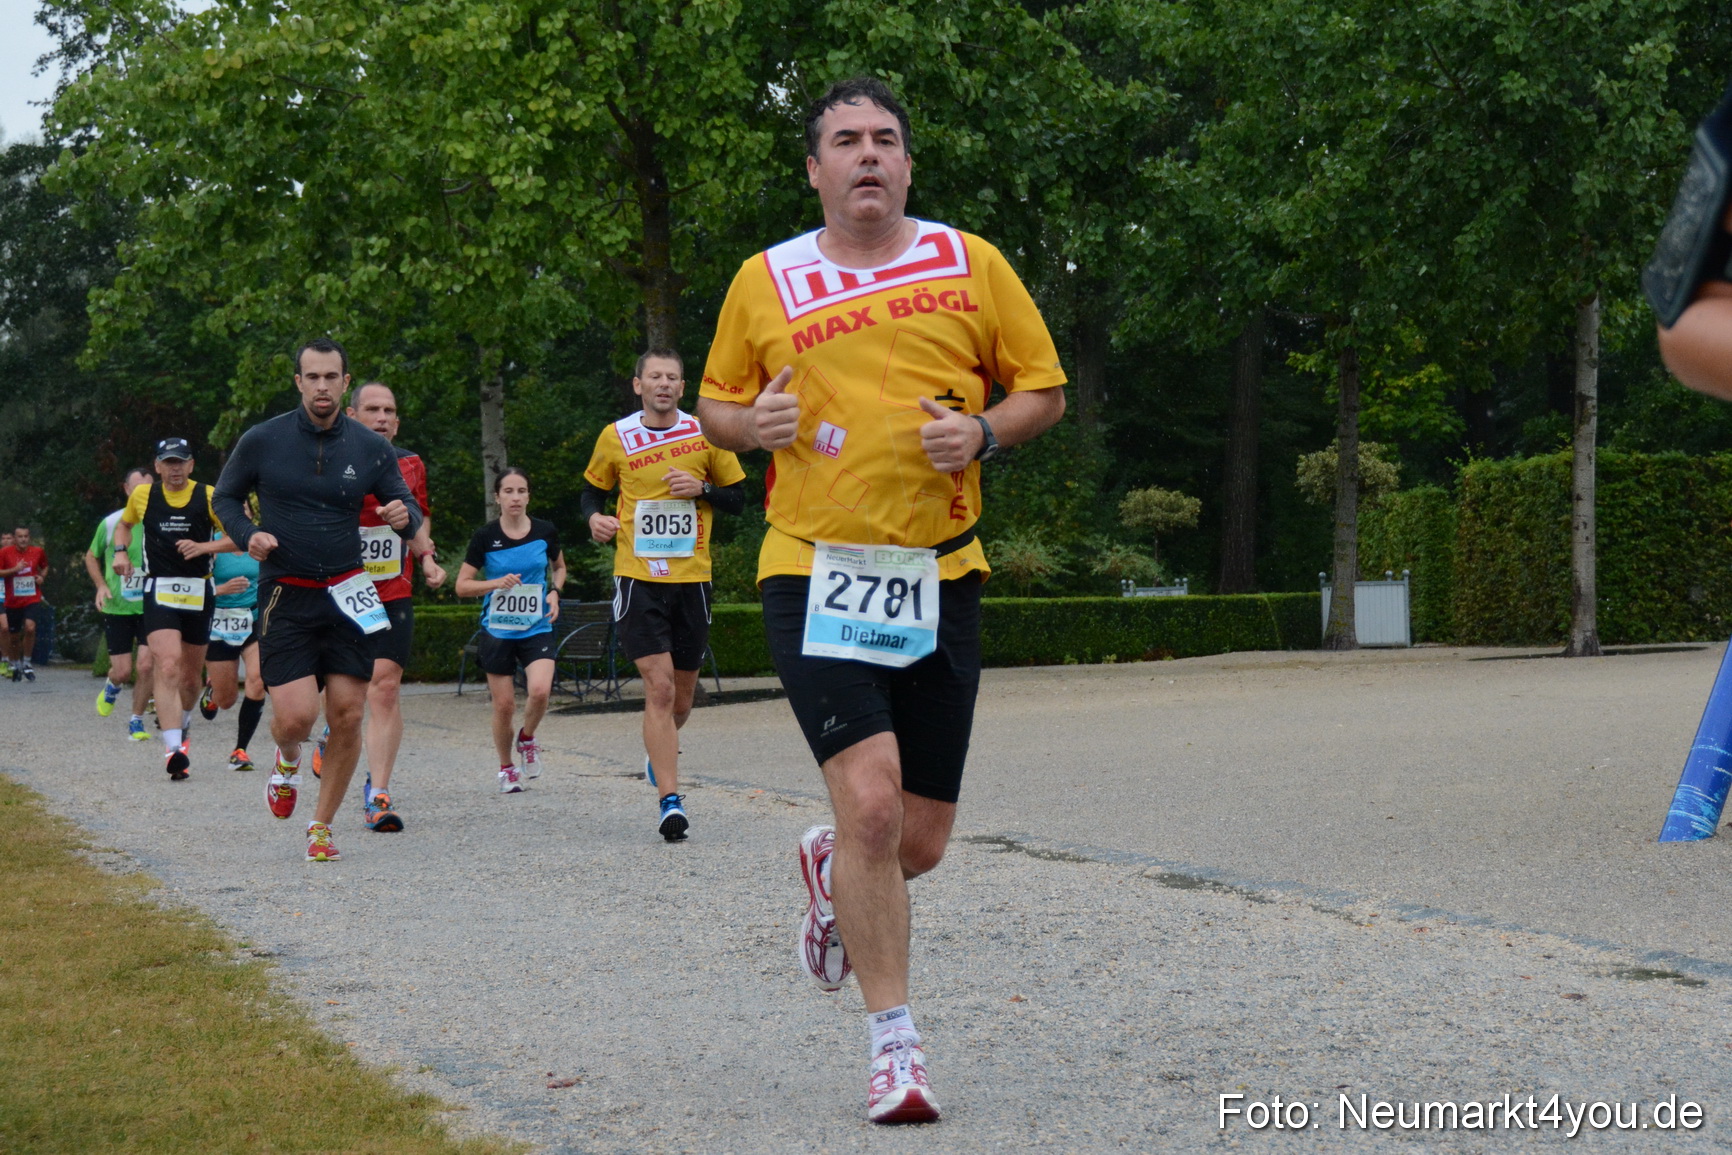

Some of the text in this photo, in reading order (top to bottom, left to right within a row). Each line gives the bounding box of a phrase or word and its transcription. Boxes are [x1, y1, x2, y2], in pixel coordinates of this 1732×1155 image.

[791, 287, 979, 355] MAX BÖGL
[628, 440, 709, 471] MAX BÖGL
[642, 514, 692, 535] 3053
[647, 539, 674, 549] Bernd
[496, 595, 538, 613] 2009
[824, 570, 923, 621] 2781
[212, 617, 249, 631] 2134
[841, 624, 908, 650] Dietmar
